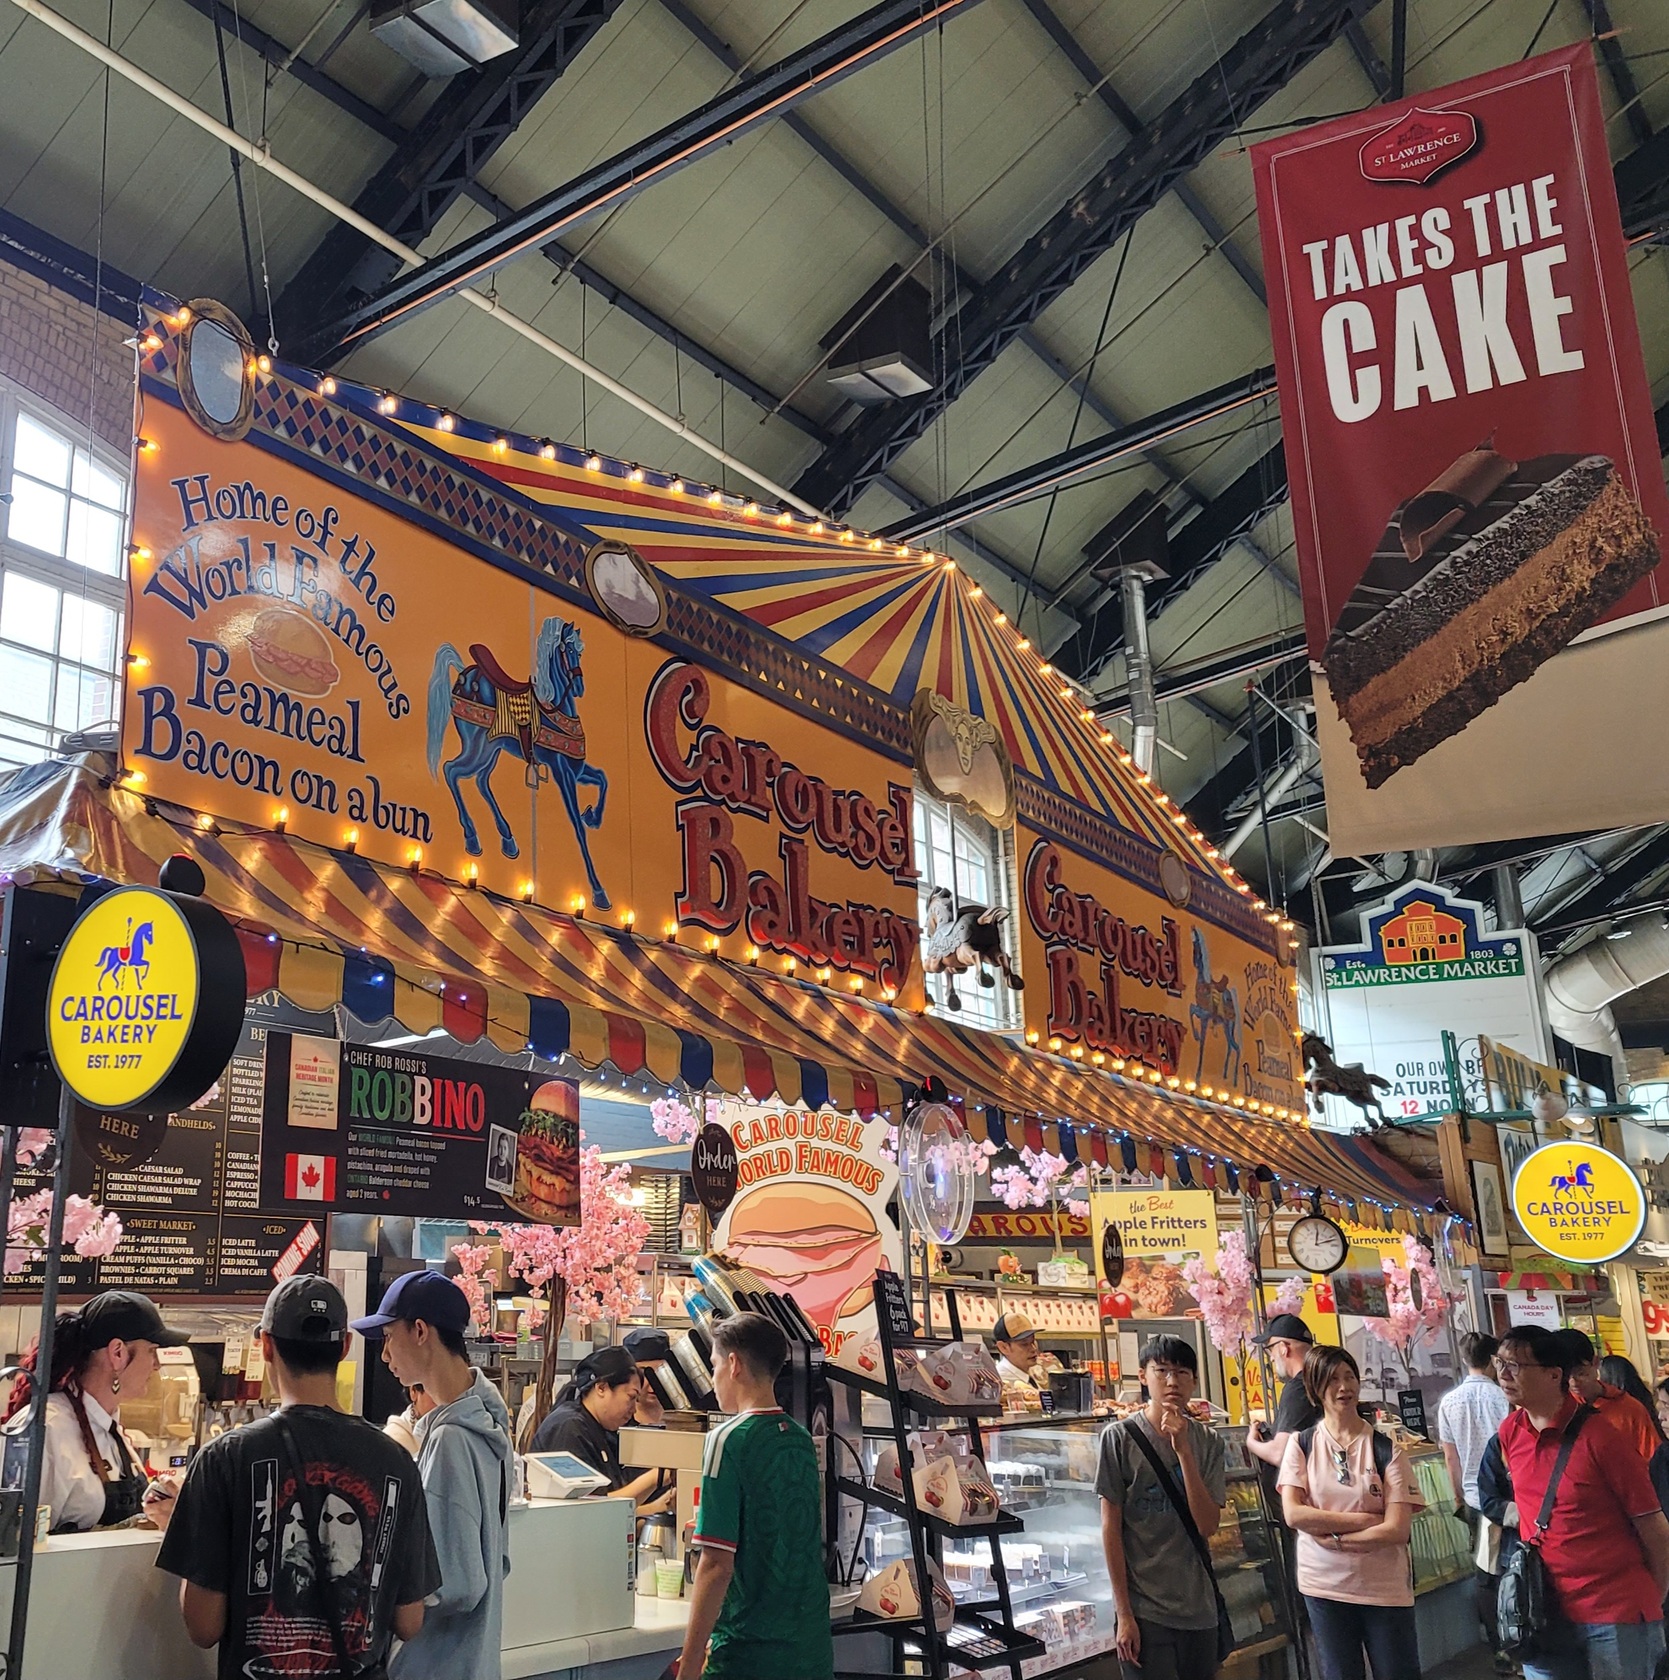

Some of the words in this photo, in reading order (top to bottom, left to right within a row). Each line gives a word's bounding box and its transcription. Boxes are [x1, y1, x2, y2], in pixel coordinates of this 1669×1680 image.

[1389, 132, 1462, 163] LAWRENCE
[1400, 152, 1438, 171] MARKET
[1302, 206, 1456, 301] TAKES
[1463, 173, 1563, 258] THE
[1321, 243, 1585, 424] CAKE
[170, 472, 290, 533] Home
[294, 505, 339, 555] of
[338, 532, 397, 624] the
[143, 534, 284, 623] World
[289, 544, 411, 722] Famous
[186, 637, 366, 764] Peameal
[134, 685, 284, 797] Bacon
[289, 767, 340, 815] on
[643, 655, 922, 890] Carousel
[674, 795, 924, 999] Bakery
[1023, 836, 1187, 998] Carousel
[1345, 959, 1366, 970] Est.
[1469, 949, 1494, 960] 1803
[1341, 964, 1440, 986] LAWRENCE
[1443, 957, 1519, 979] MARKET
[60, 993, 183, 1022] CAROUSEL
[1046, 940, 1188, 1076] Bakery
[80, 1023, 158, 1045] BAKERY
[87, 1054, 111, 1070] EST.
[113, 1054, 143, 1070] 1977
[350, 1050, 373, 1067] CHEF
[375, 1054, 393, 1070] ROB
[394, 1058, 427, 1074] ROSSI'S
[1256, 1038, 1294, 1082] Peameal
[232, 1068, 260, 1077] BOTTLED
[1395, 1061, 1425, 1079] OUR
[231, 1095, 245, 1104] ICED
[246, 1097, 257, 1105] TEA
[350, 1066, 486, 1132] ROBBINO
[1401, 1099, 1420, 1115] 12
[169, 1118, 213, 1130] ANDHELDS
[229, 1114, 247, 1123] APPLE
[99, 1114, 140, 1140] HERE
[730, 1111, 865, 1152] CAROUSEL
[227, 1151, 250, 1160] COFFEE
[698, 1138, 737, 1172] Order
[139, 1164, 162, 1174] CAESAR
[163, 1166, 184, 1175] SALAD
[226, 1171, 255, 1180] ESPRESSO
[736, 1147, 792, 1191] ORLD
[795, 1141, 885, 1195] FAMOUS
[13, 1177, 36, 1187] HEESE
[107, 1172, 138, 1182] CHICKEN
[138, 1175, 162, 1183] CAESAR
[163, 1176, 183, 1184] SALAD
[183, 1178, 202, 1186] WRAP
[706, 1175, 727, 1188] HERE
[106, 1183, 137, 1192] CHICKEN
[106, 1193, 136, 1202] CHICKEN
[1129, 1200, 1147, 1214] the
[1146, 1195, 1175, 1211] Best
[1526, 1200, 1631, 1216] CAROUSEL
[130, 1218, 158, 1230] SWEET
[159, 1220, 193, 1231] MARKET
[265, 1224, 284, 1235] ICED
[969, 1213, 1089, 1236] AROUS
[1150, 1215, 1207, 1230] Fritters
[1549, 1216, 1612, 1229] BAKERY
[140, 1236, 160, 1244] APPLE
[160, 1236, 187, 1245] FRITTER
[222, 1238, 237, 1246] ICED
[237, 1238, 256, 1247] LATTE
[297, 1221, 319, 1255] SOON
[1124, 1234, 1138, 1247] in
[1141, 1233, 1187, 1248] town!
[1346, 1235, 1401, 1246] Turnovers
[1559, 1232, 1580, 1242] EST.
[1581, 1231, 1605, 1241] 1977
[139, 1246, 159, 1254] APPLE
[159, 1247, 194, 1255] TURNOVER
[221, 1247, 236, 1256] ICED
[236, 1248, 261, 1257] VANILLA
[101, 1254, 125, 1263] CREAM
[125, 1256, 145, 1264] PUFFS
[220, 1257, 236, 1266] ICED
[236, 1258, 259, 1266] MOCHA
[100, 1266, 135, 1274] BROWNIES
[140, 1266, 166, 1275] CARROT
[166, 1267, 194, 1275] SQUARES
[220, 1267, 241, 1275] CREMA
[99, 1276, 124, 1284] PASTEL
[134, 1277, 154, 1285] NATAS
[158, 1277, 179, 1285] PLAIN
[895, 1307, 908, 1320] pack
